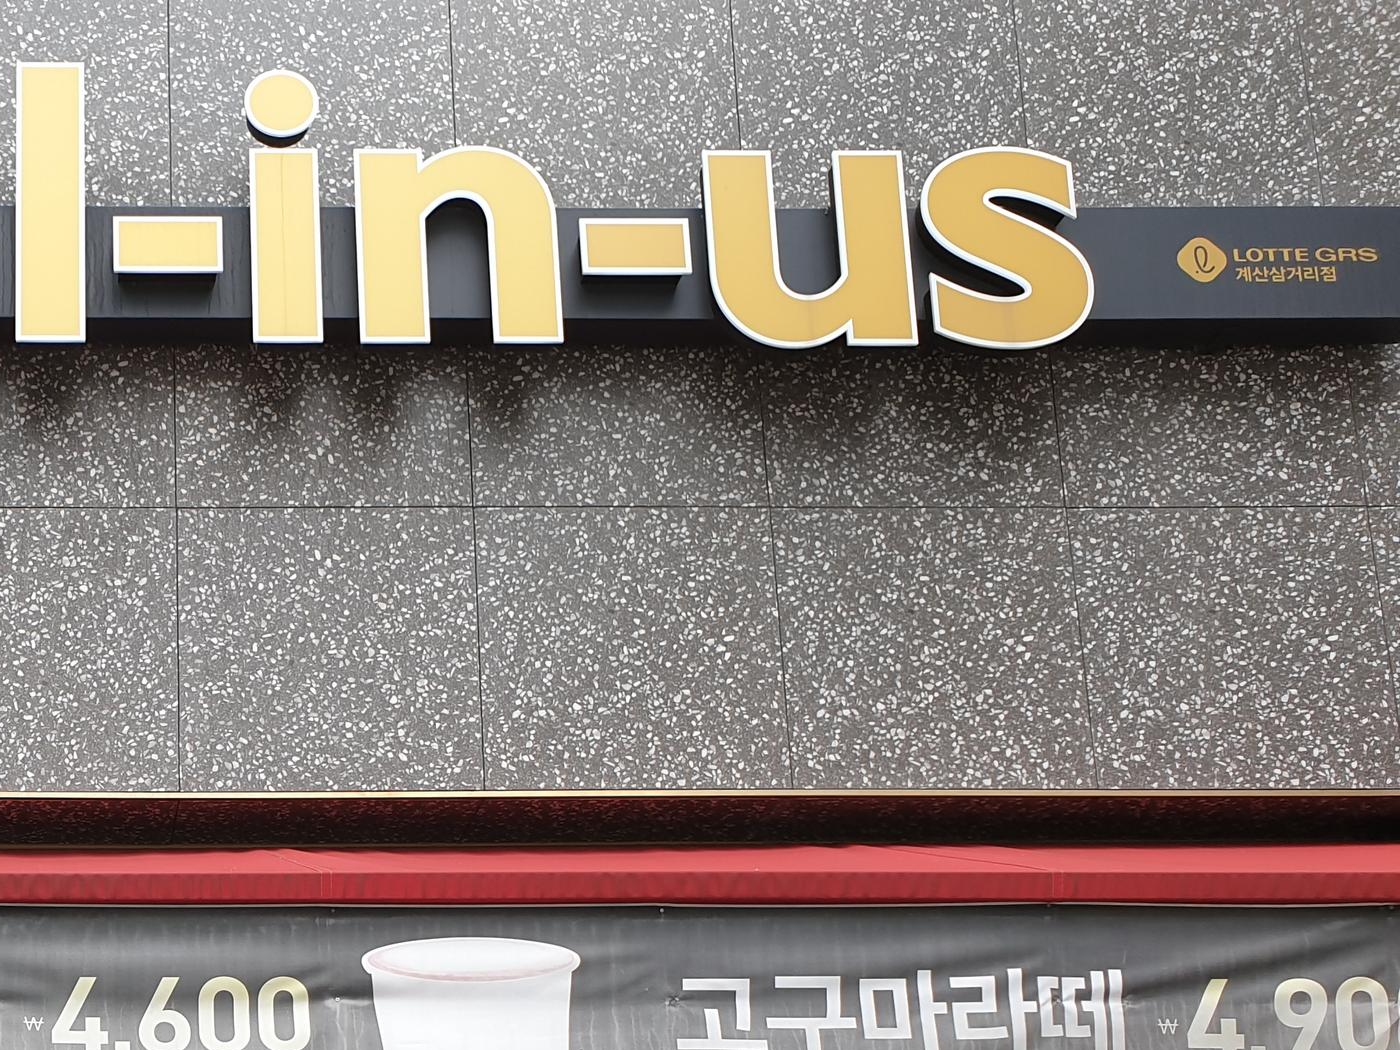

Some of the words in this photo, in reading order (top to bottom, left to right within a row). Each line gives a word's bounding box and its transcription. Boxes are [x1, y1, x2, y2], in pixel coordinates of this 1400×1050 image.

[1232, 247, 1310, 264] LOTTE
[1315, 246, 1379, 264] GRS
[1234, 265, 1339, 284] 계산삼거리점
